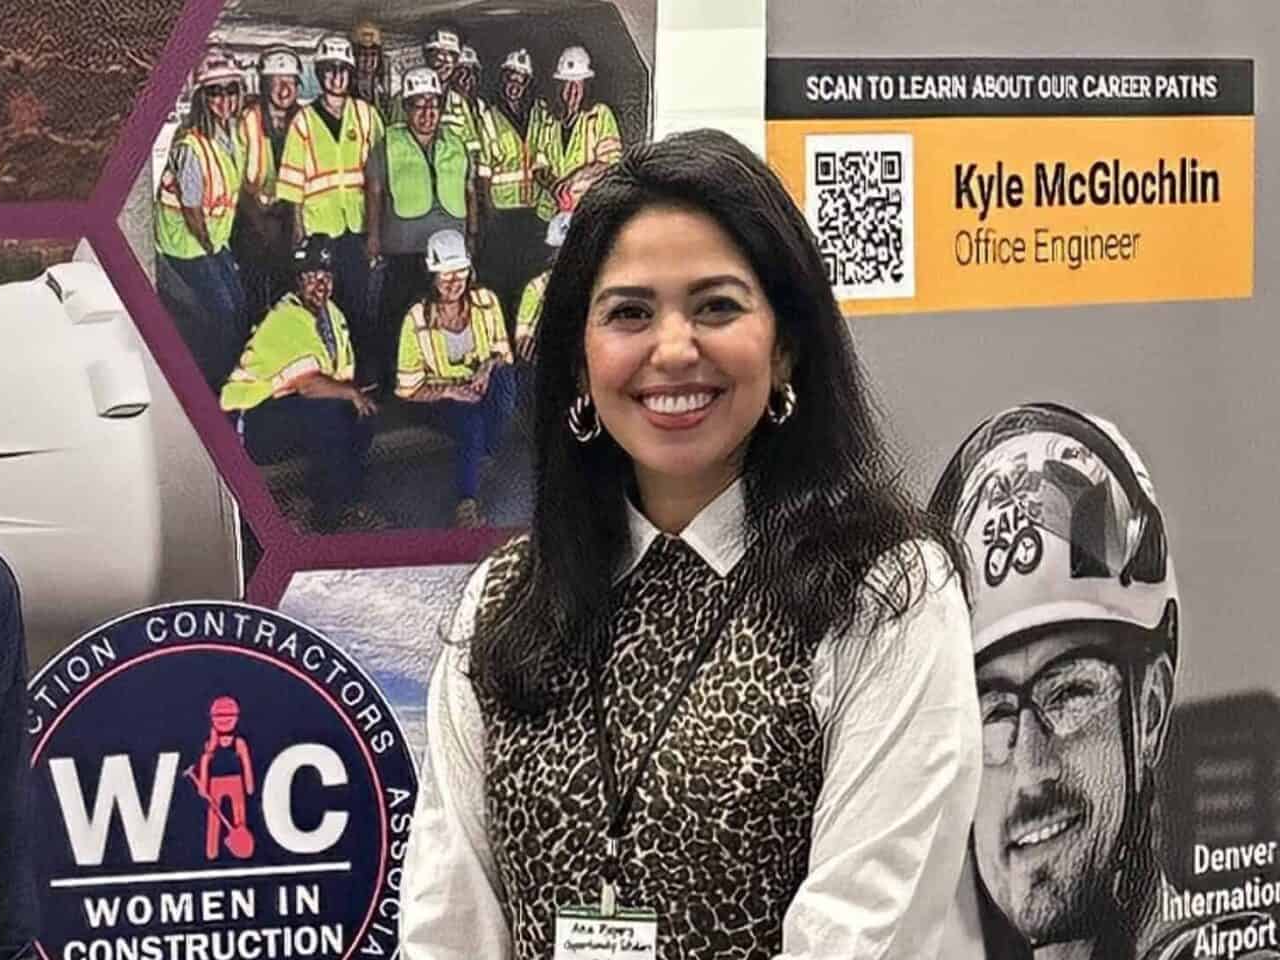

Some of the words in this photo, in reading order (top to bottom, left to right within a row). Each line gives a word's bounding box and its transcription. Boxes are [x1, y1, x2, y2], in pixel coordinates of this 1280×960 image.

[806, 76, 862, 101] SCAN
[870, 76, 894, 101] TO
[899, 75, 967, 100] LEARN
[972, 75, 1032, 99] ABOUT
[1037, 75, 1078, 98] OUR
[1083, 74, 1151, 98] CAREER
[1155, 74, 1218, 98] PATHS
[954, 162, 1024, 221] Kyle
[1034, 157, 1221, 208] McGlochlin
[954, 228, 1026, 267] Office
[1034, 228, 1141, 270] Engineer
[146, 611, 395, 756] CONTRACTORS
[1194, 841, 1277, 875] Denver
[83, 887, 256, 928] WOMEN
[278, 884, 321, 915] IN
[1193, 919, 1278, 960] Airport
